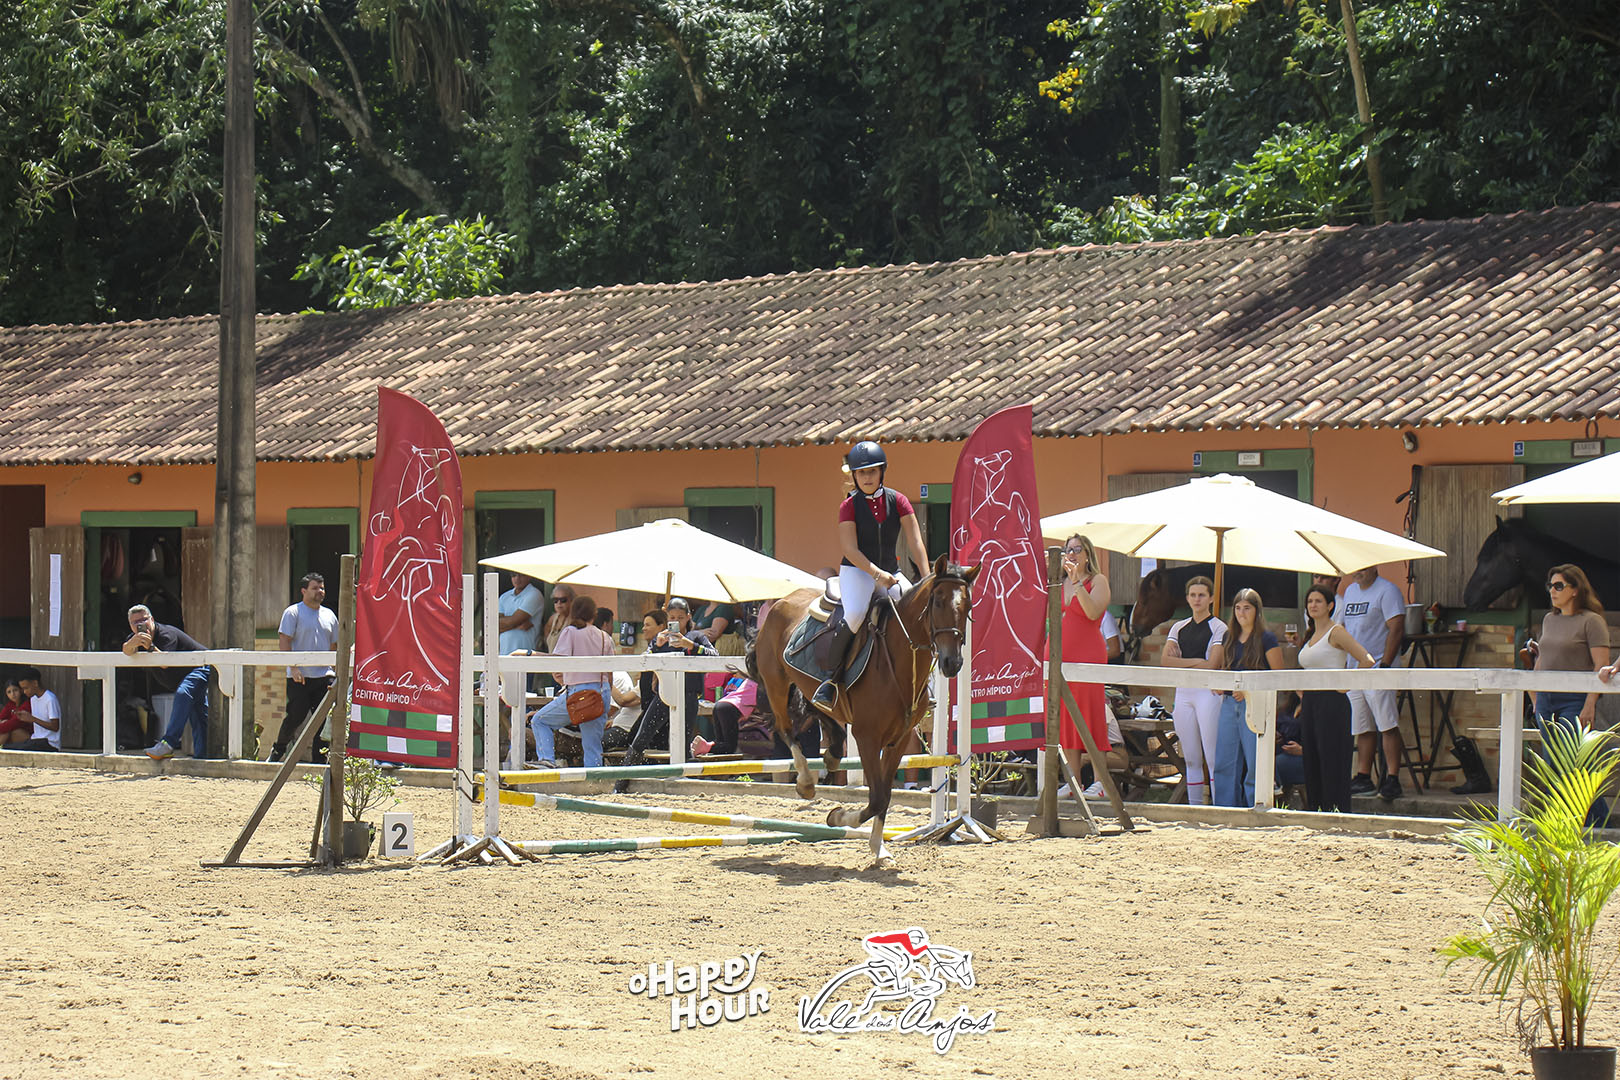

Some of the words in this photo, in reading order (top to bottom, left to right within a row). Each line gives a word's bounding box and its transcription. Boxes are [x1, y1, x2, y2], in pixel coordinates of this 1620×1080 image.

[396, 671, 443, 701] Anjos
[997, 662, 1036, 689] Anjos
[355, 688, 384, 702] CENTRO
[386, 692, 410, 705] HÍPICO
[986, 684, 1012, 697] HÍPICO
[391, 822, 408, 850] 2
